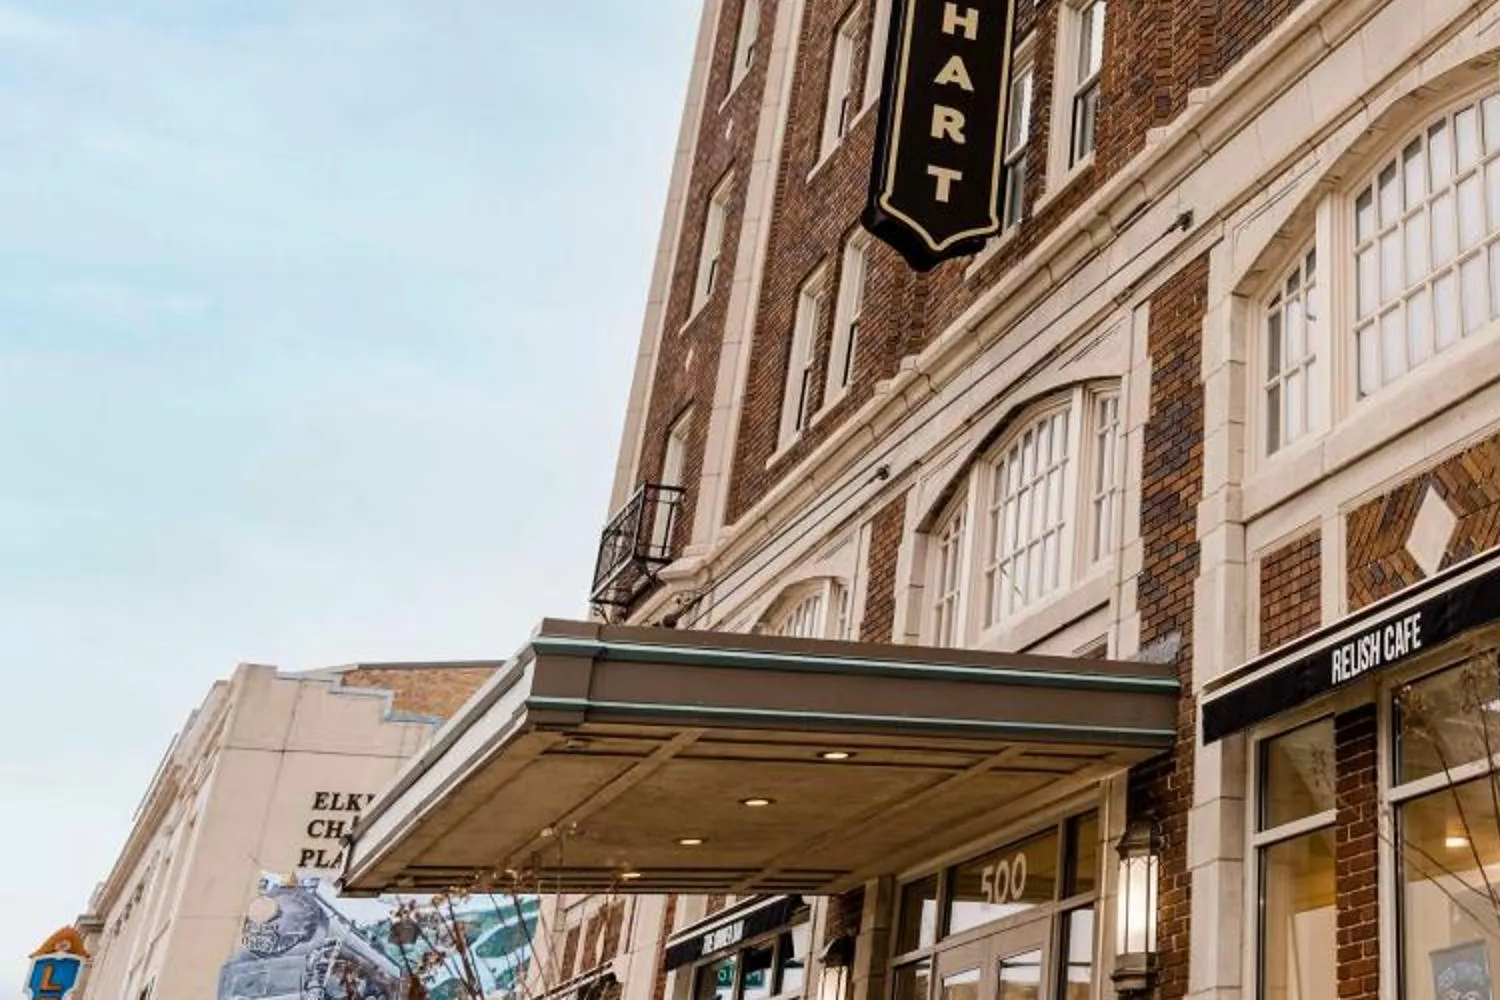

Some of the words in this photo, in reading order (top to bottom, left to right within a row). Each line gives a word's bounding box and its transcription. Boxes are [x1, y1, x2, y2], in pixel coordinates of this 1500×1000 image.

[1331, 629, 1380, 685] RELISH
[1383, 611, 1421, 661] CAFE
[307, 815, 359, 839] CH
[981, 852, 1026, 906] 500
